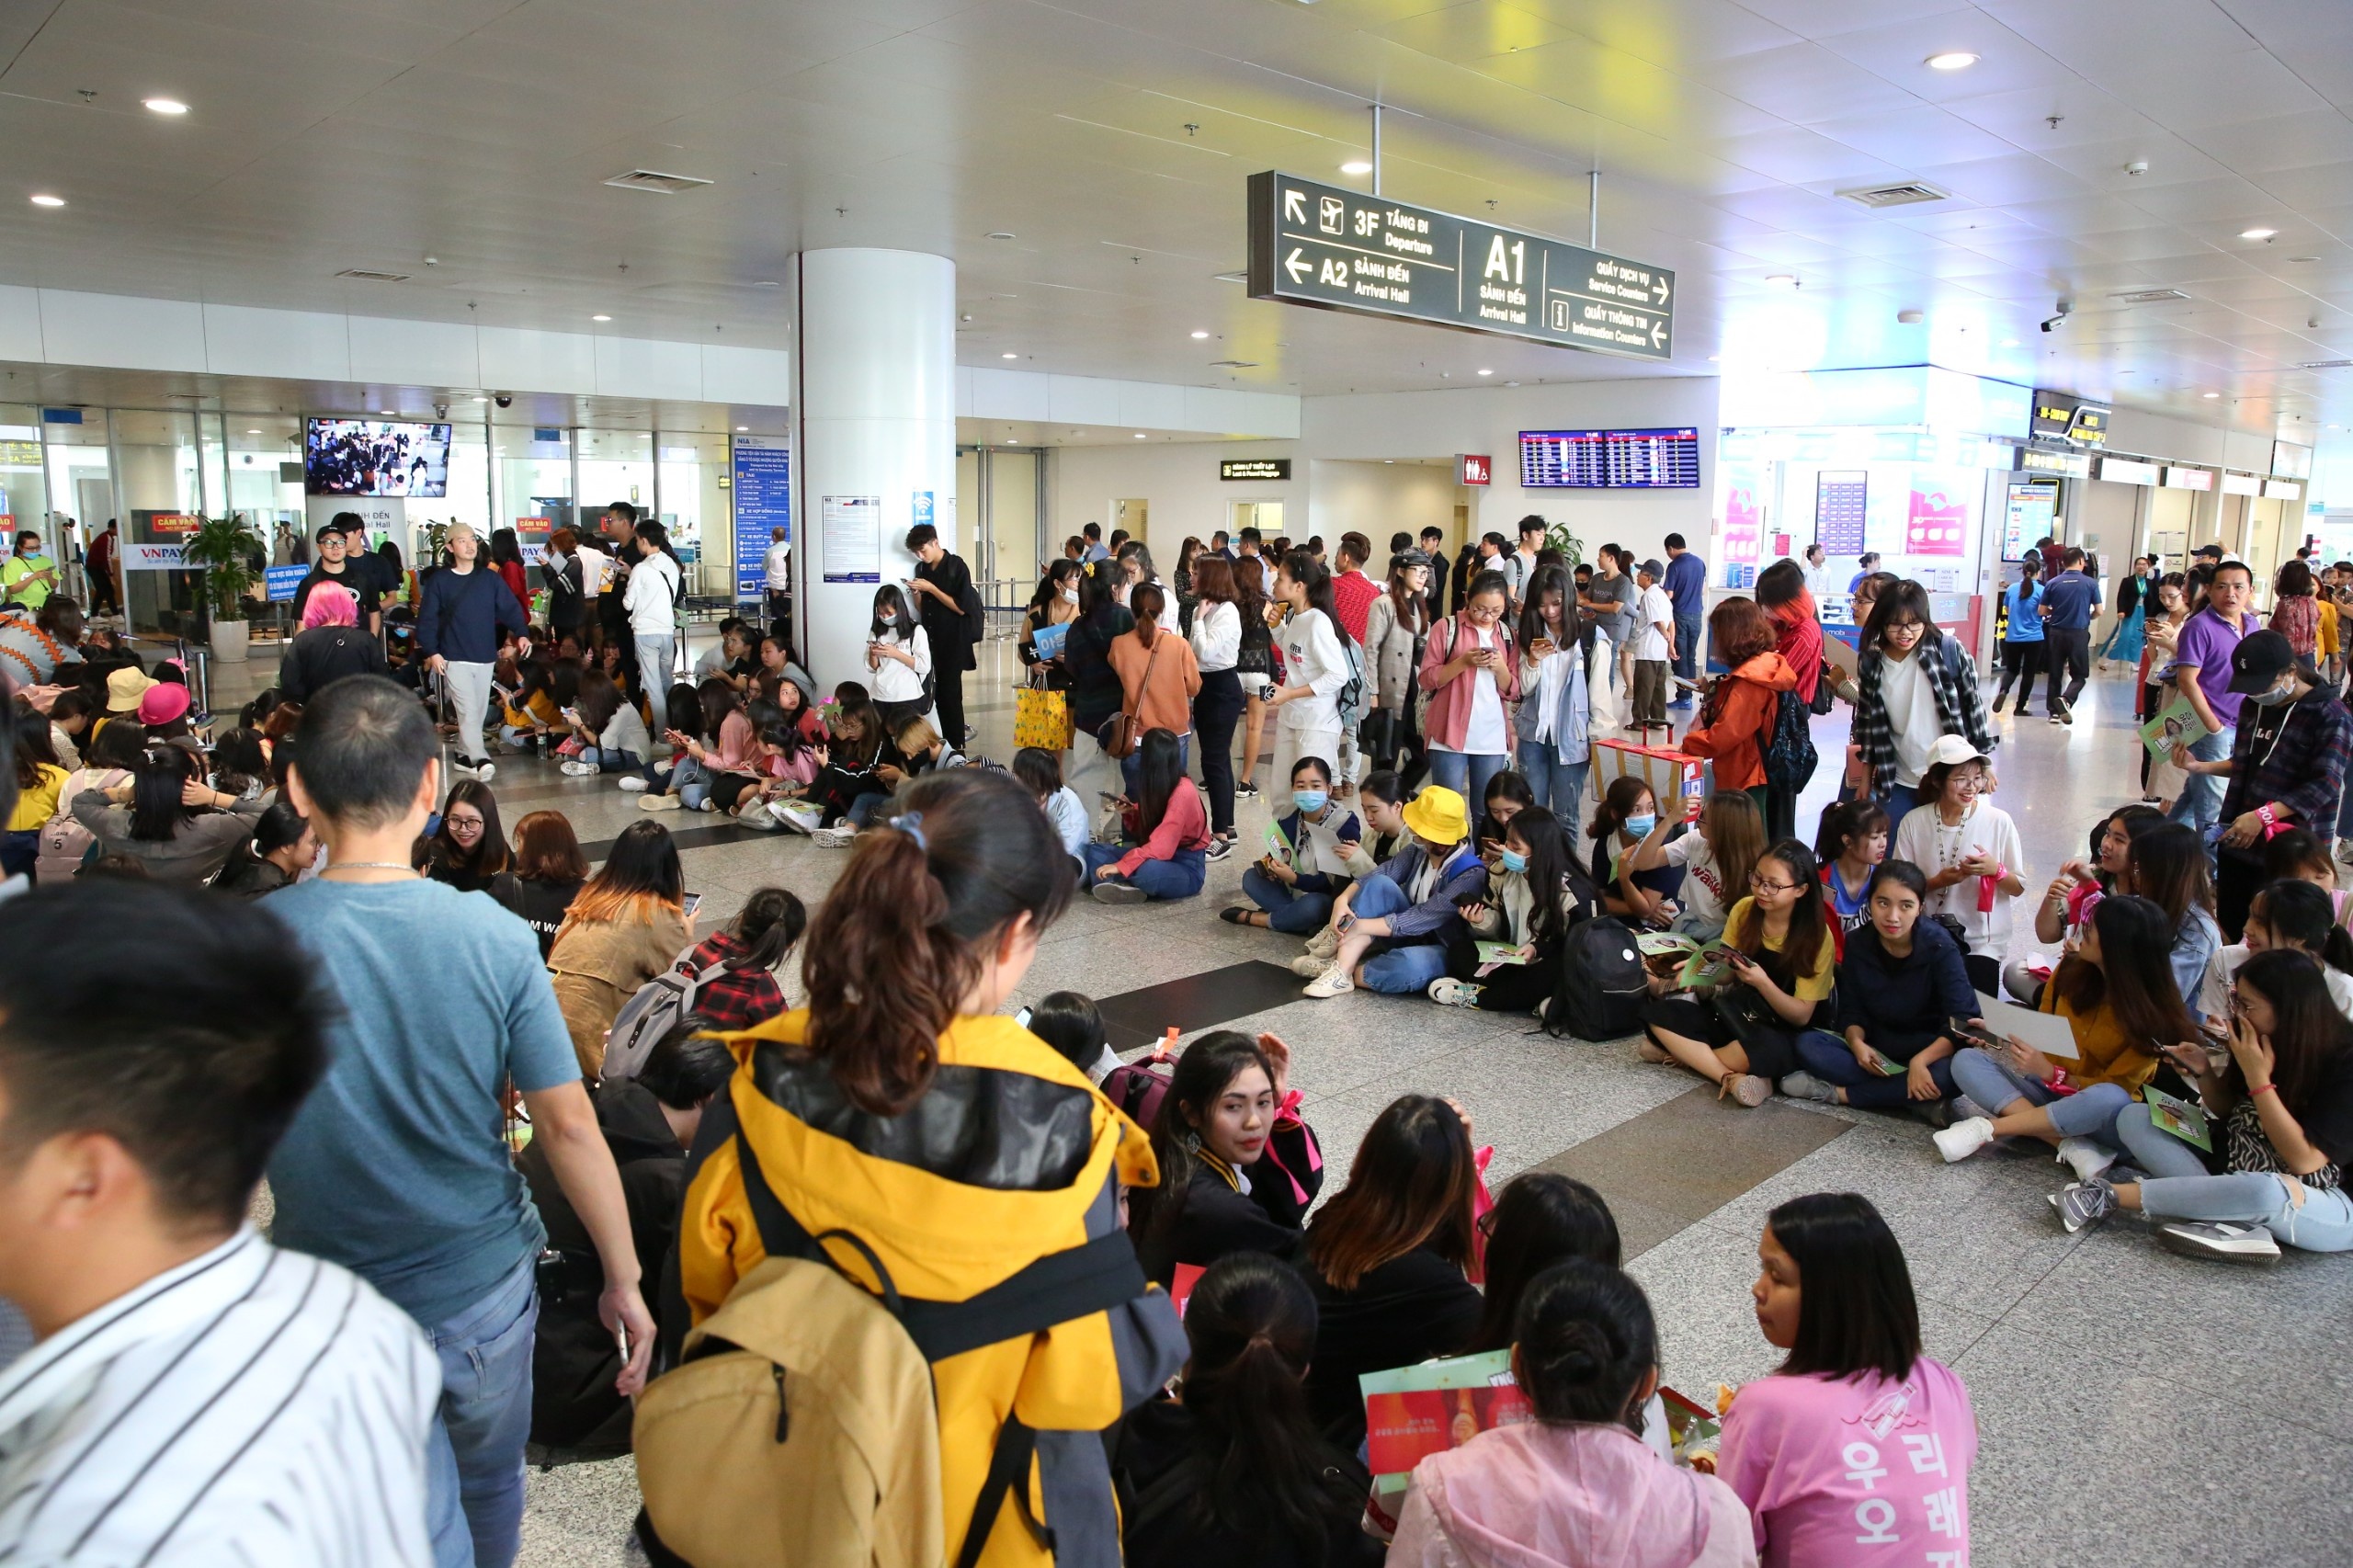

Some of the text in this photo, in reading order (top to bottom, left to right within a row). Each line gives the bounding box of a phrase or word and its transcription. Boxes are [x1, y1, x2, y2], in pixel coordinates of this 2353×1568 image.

[1355, 210, 1379, 236] 3F
[1417, 219, 1428, 234] ĐI
[1385, 233, 1433, 255] Departure
[1354, 256, 1409, 283] SẢNH ĐẾN
[1483, 234, 1524, 285] A1
[1320, 257, 1347, 288] A2
[1620, 267, 1638, 283] DỊCH
[1639, 272, 1650, 287] VỤ
[1354, 280, 1409, 303] Arrival Hall
[1480, 283, 1526, 306] SẢNH ĐẾN
[1588, 278, 1649, 302] Service Counters
[1480, 304, 1527, 324] Arrival Hall
[1607, 310, 1634, 327] THÔNG
[1635, 316, 1648, 330] TIN
[1573, 322, 1646, 347] Information Counters
[372, 509, 390, 519] ĐẾN
[54, 838, 63, 850] 5
